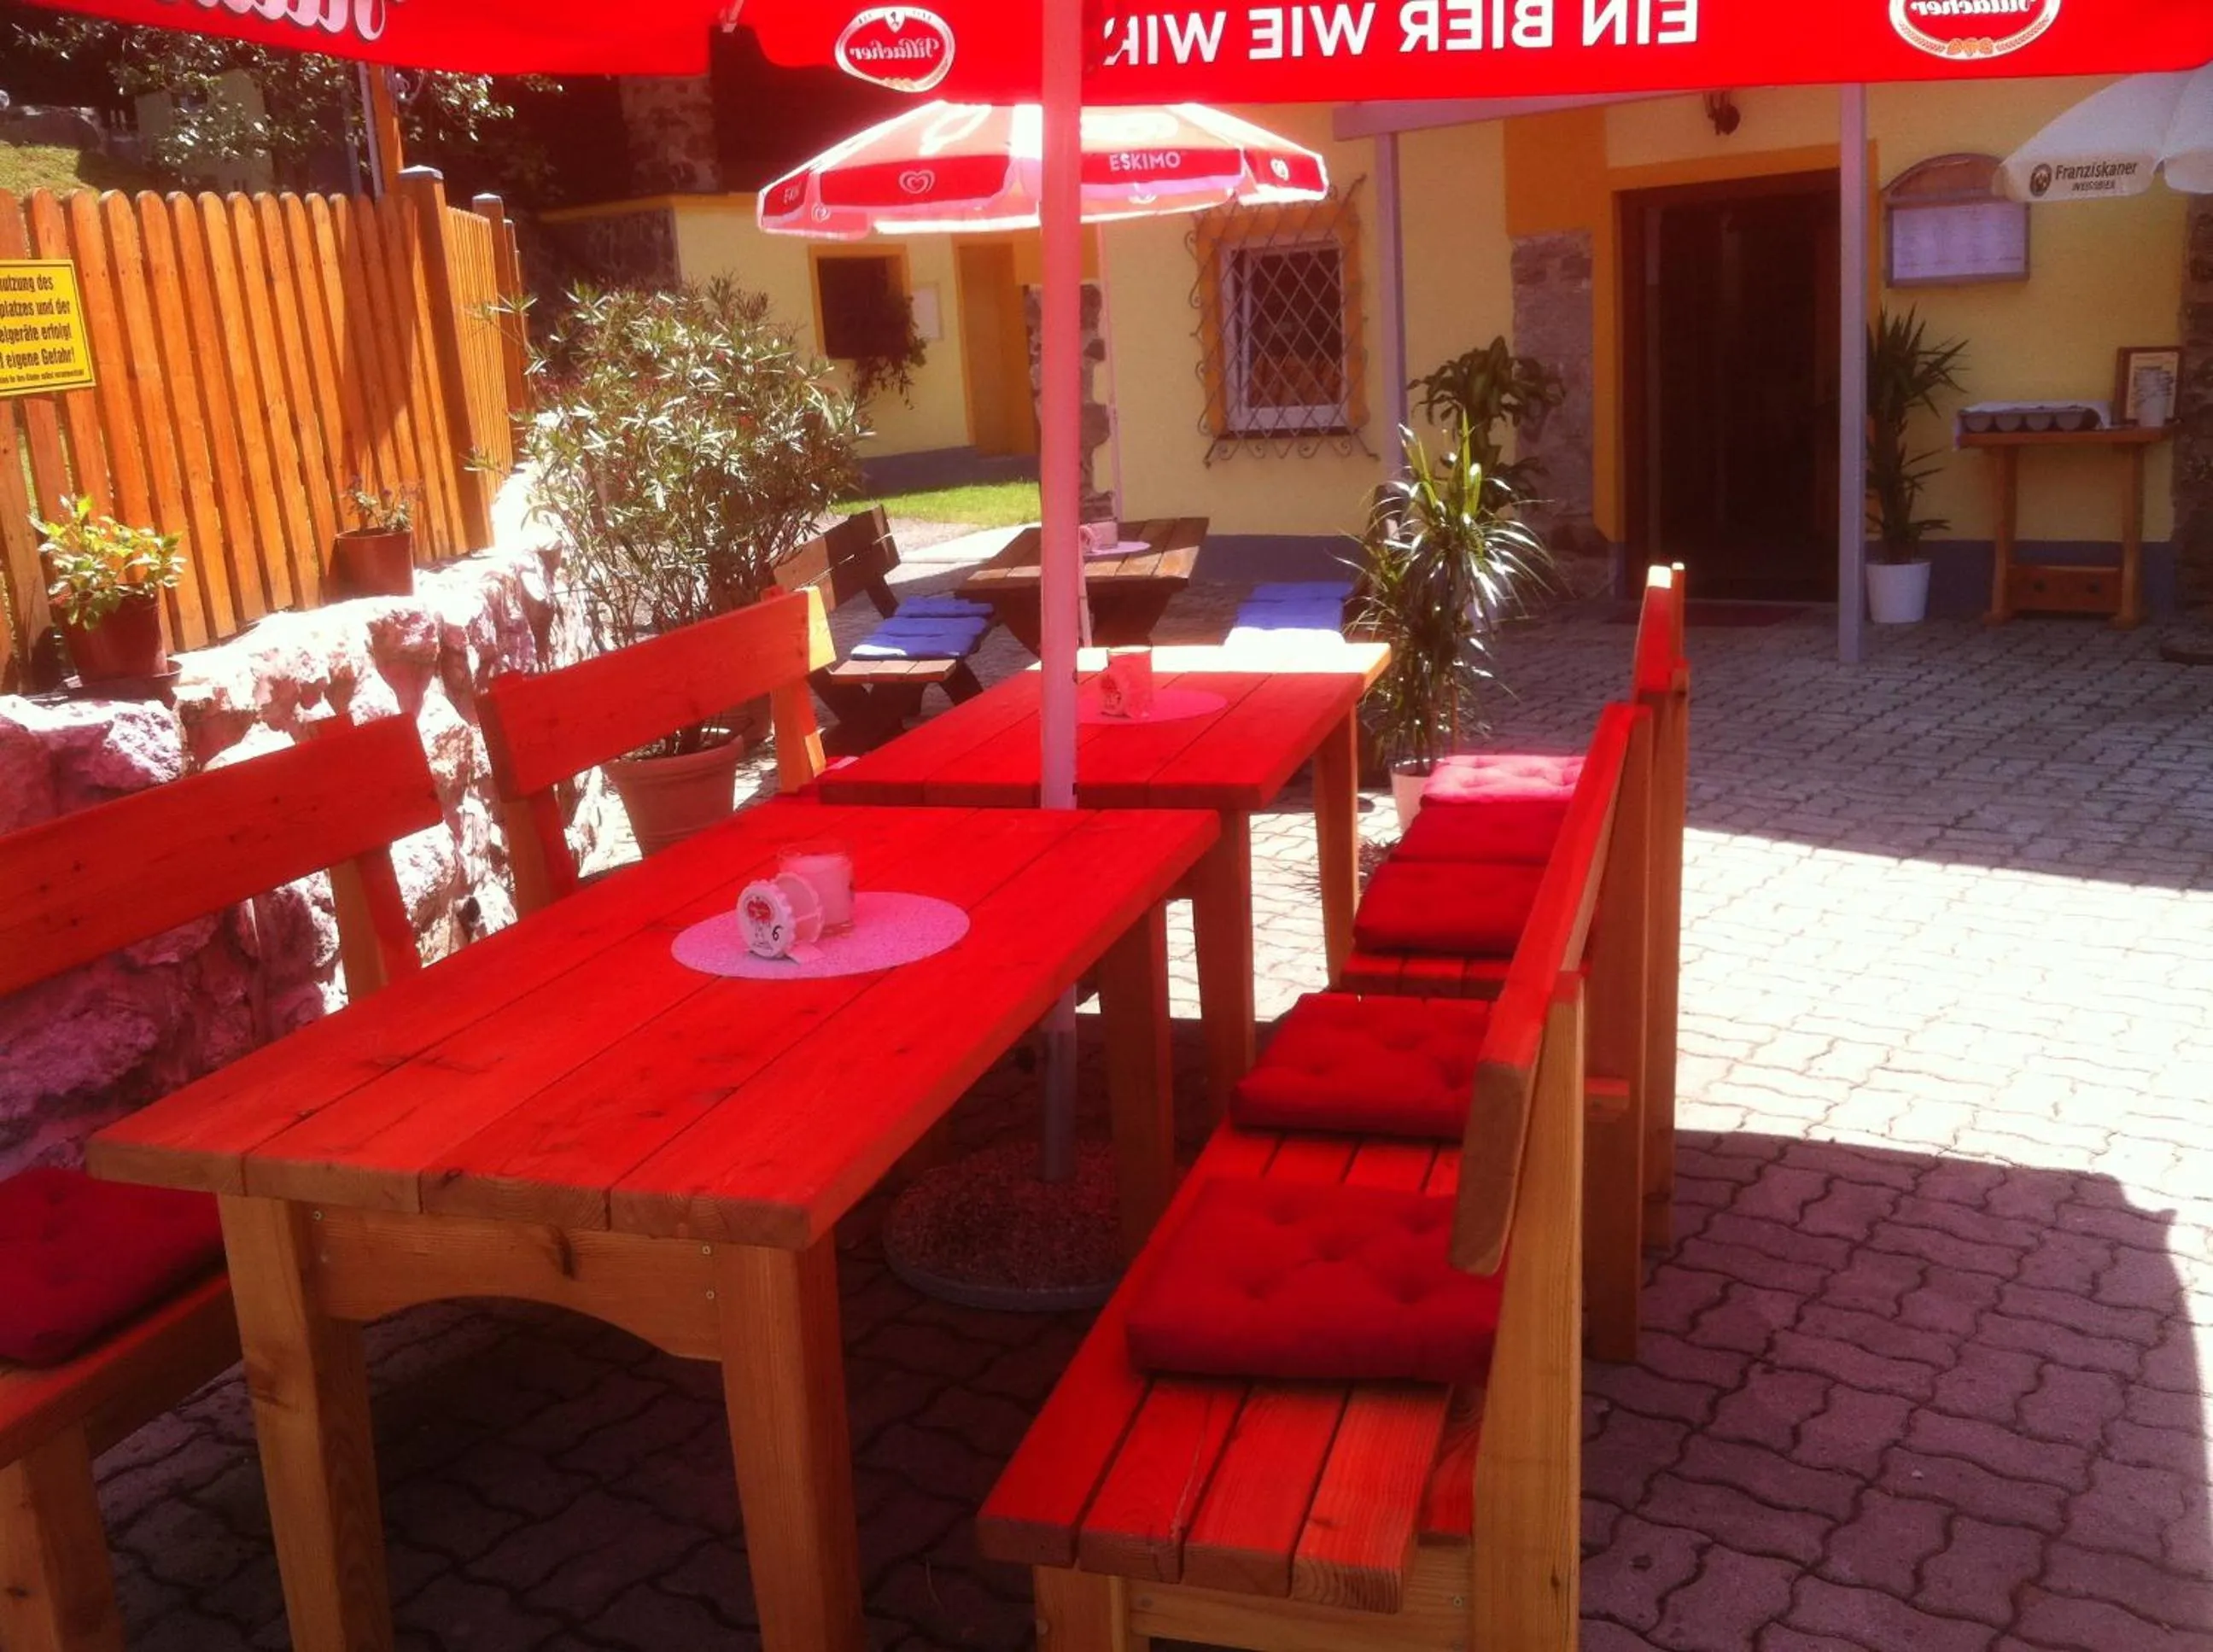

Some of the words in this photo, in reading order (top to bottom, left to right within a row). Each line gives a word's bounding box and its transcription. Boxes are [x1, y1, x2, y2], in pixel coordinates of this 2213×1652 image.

[1110, 151, 1181, 171] ESKIMO
[2055, 161, 2137, 179] Franziskaner
[37, 274, 54, 290] des
[36, 299, 55, 315] und
[55, 298, 70, 315] der
[6, 351, 39, 369] eigene
[772, 925, 784, 942] 6
